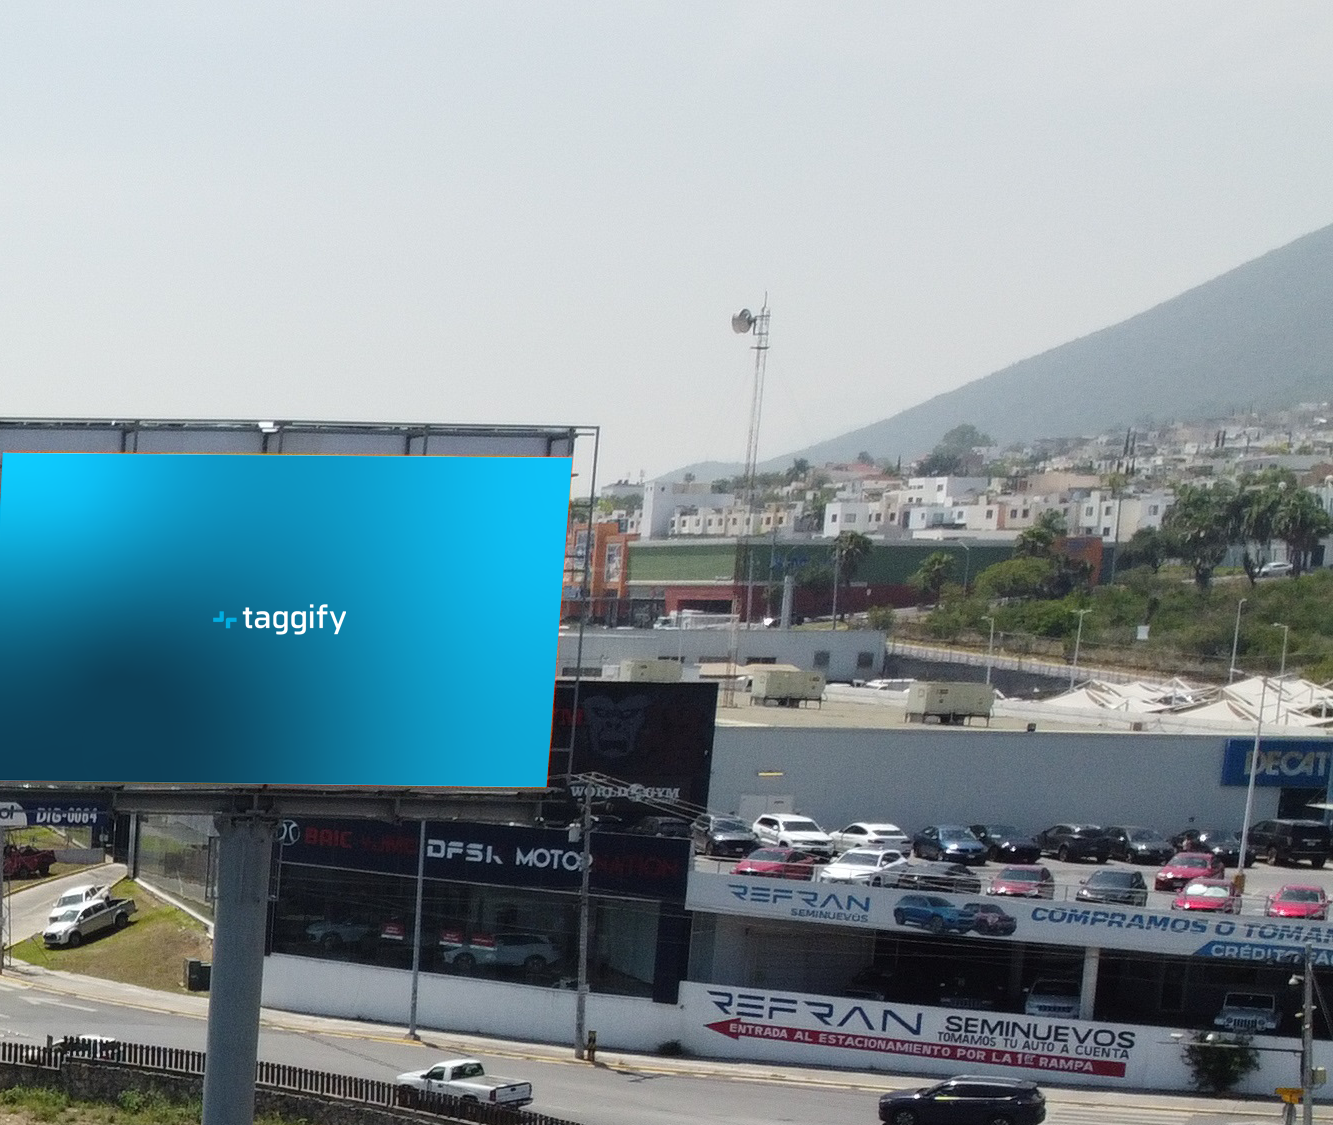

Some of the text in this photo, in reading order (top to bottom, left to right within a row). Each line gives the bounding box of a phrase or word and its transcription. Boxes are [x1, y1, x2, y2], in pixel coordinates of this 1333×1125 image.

[242, 603, 347, 636] taggify
[304, 827, 353, 849] BAIC
[727, 883, 870, 913] REFRAN
[790, 907, 869, 923] SEMINUEVOS
[1031, 905, 1209, 934] COMPRAMOS
[1214, 920, 1236, 937] O
[707, 989, 1136, 1049] REFRAN SEMINUEVOS
[729, 1023, 789, 1039] ENTRADA
[794, 1031, 813, 1042] AL
[818, 1033, 952, 1057] ESTACIONAMIENTO
[956, 1047, 987, 1061] POR
[991, 1052, 1012, 1064] LA
[1039, 1056, 1095, 1073] RAMPA
[938, 1031, 1130, 1060] TOMAMOS TU AUTO A CUENTA
